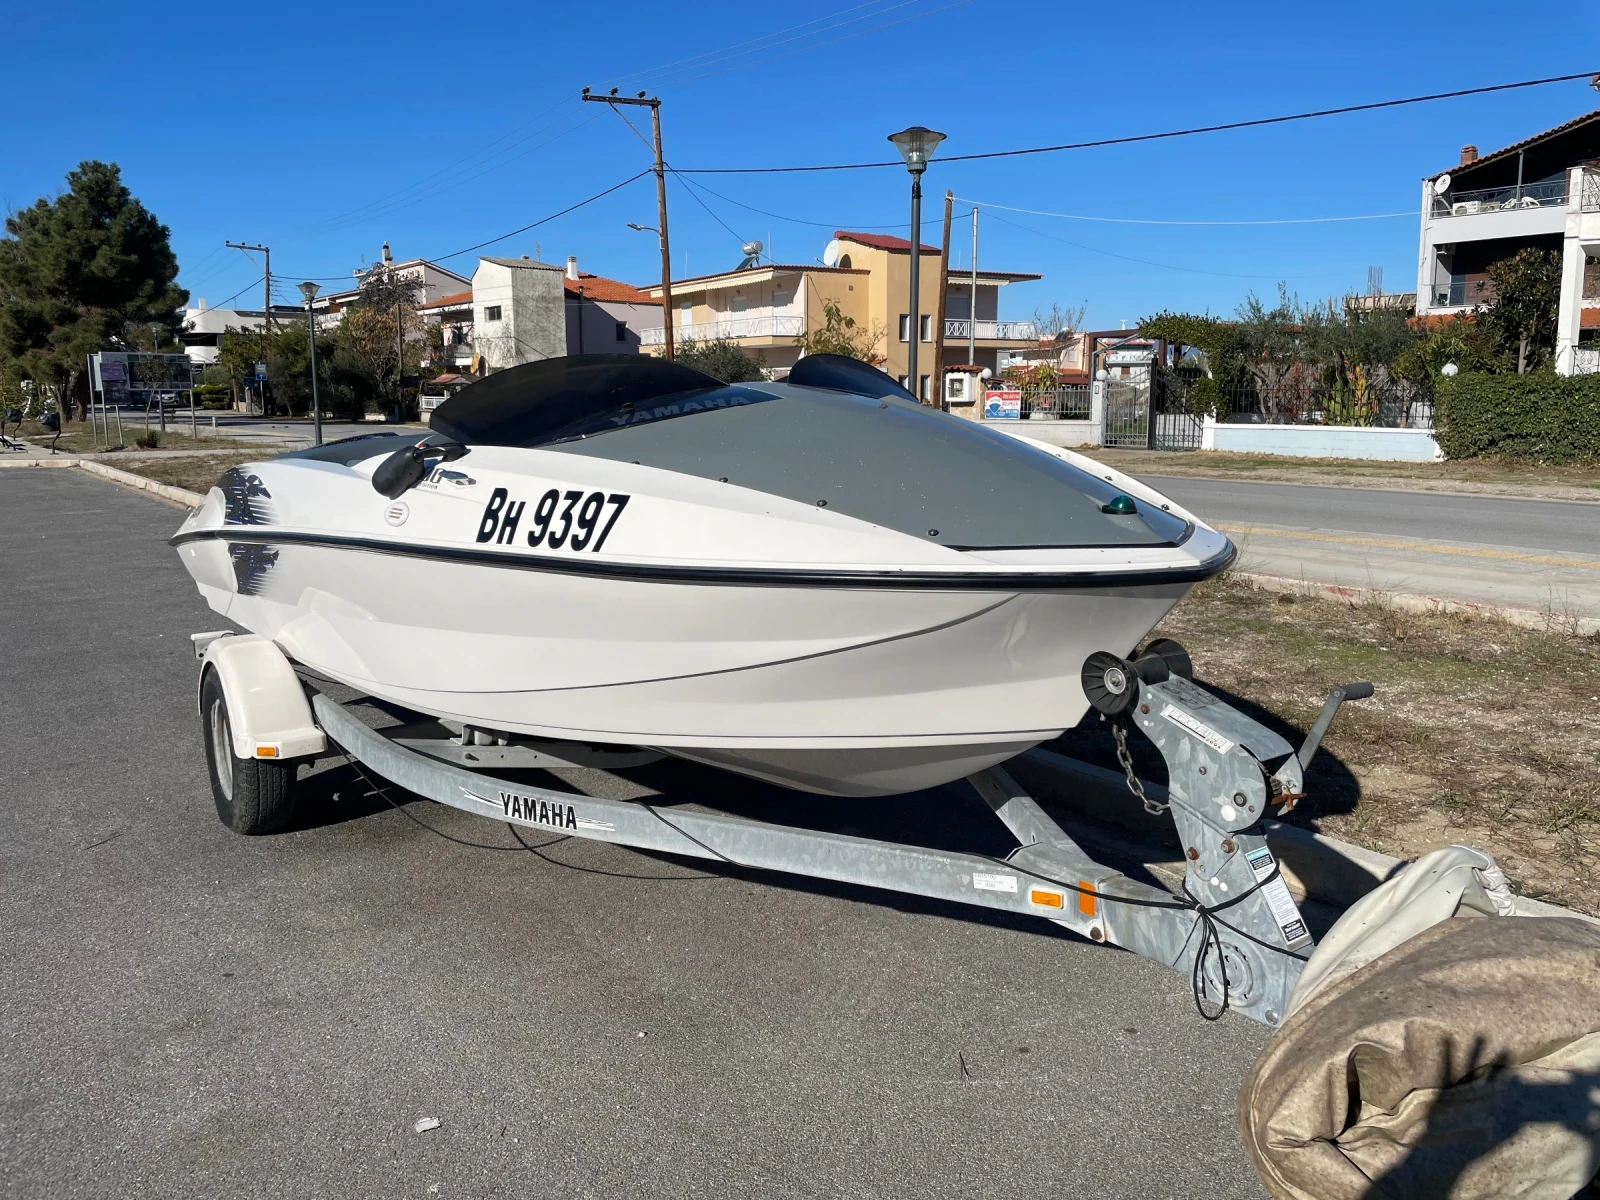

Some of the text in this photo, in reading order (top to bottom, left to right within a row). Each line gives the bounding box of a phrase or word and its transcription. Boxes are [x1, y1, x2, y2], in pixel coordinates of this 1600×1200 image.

[610, 396, 752, 426] YAMAHA
[476, 487, 631, 553] BH 9397
[1169, 708, 1227, 748] PROFILE
[500, 792, 578, 830] YAMAHA
